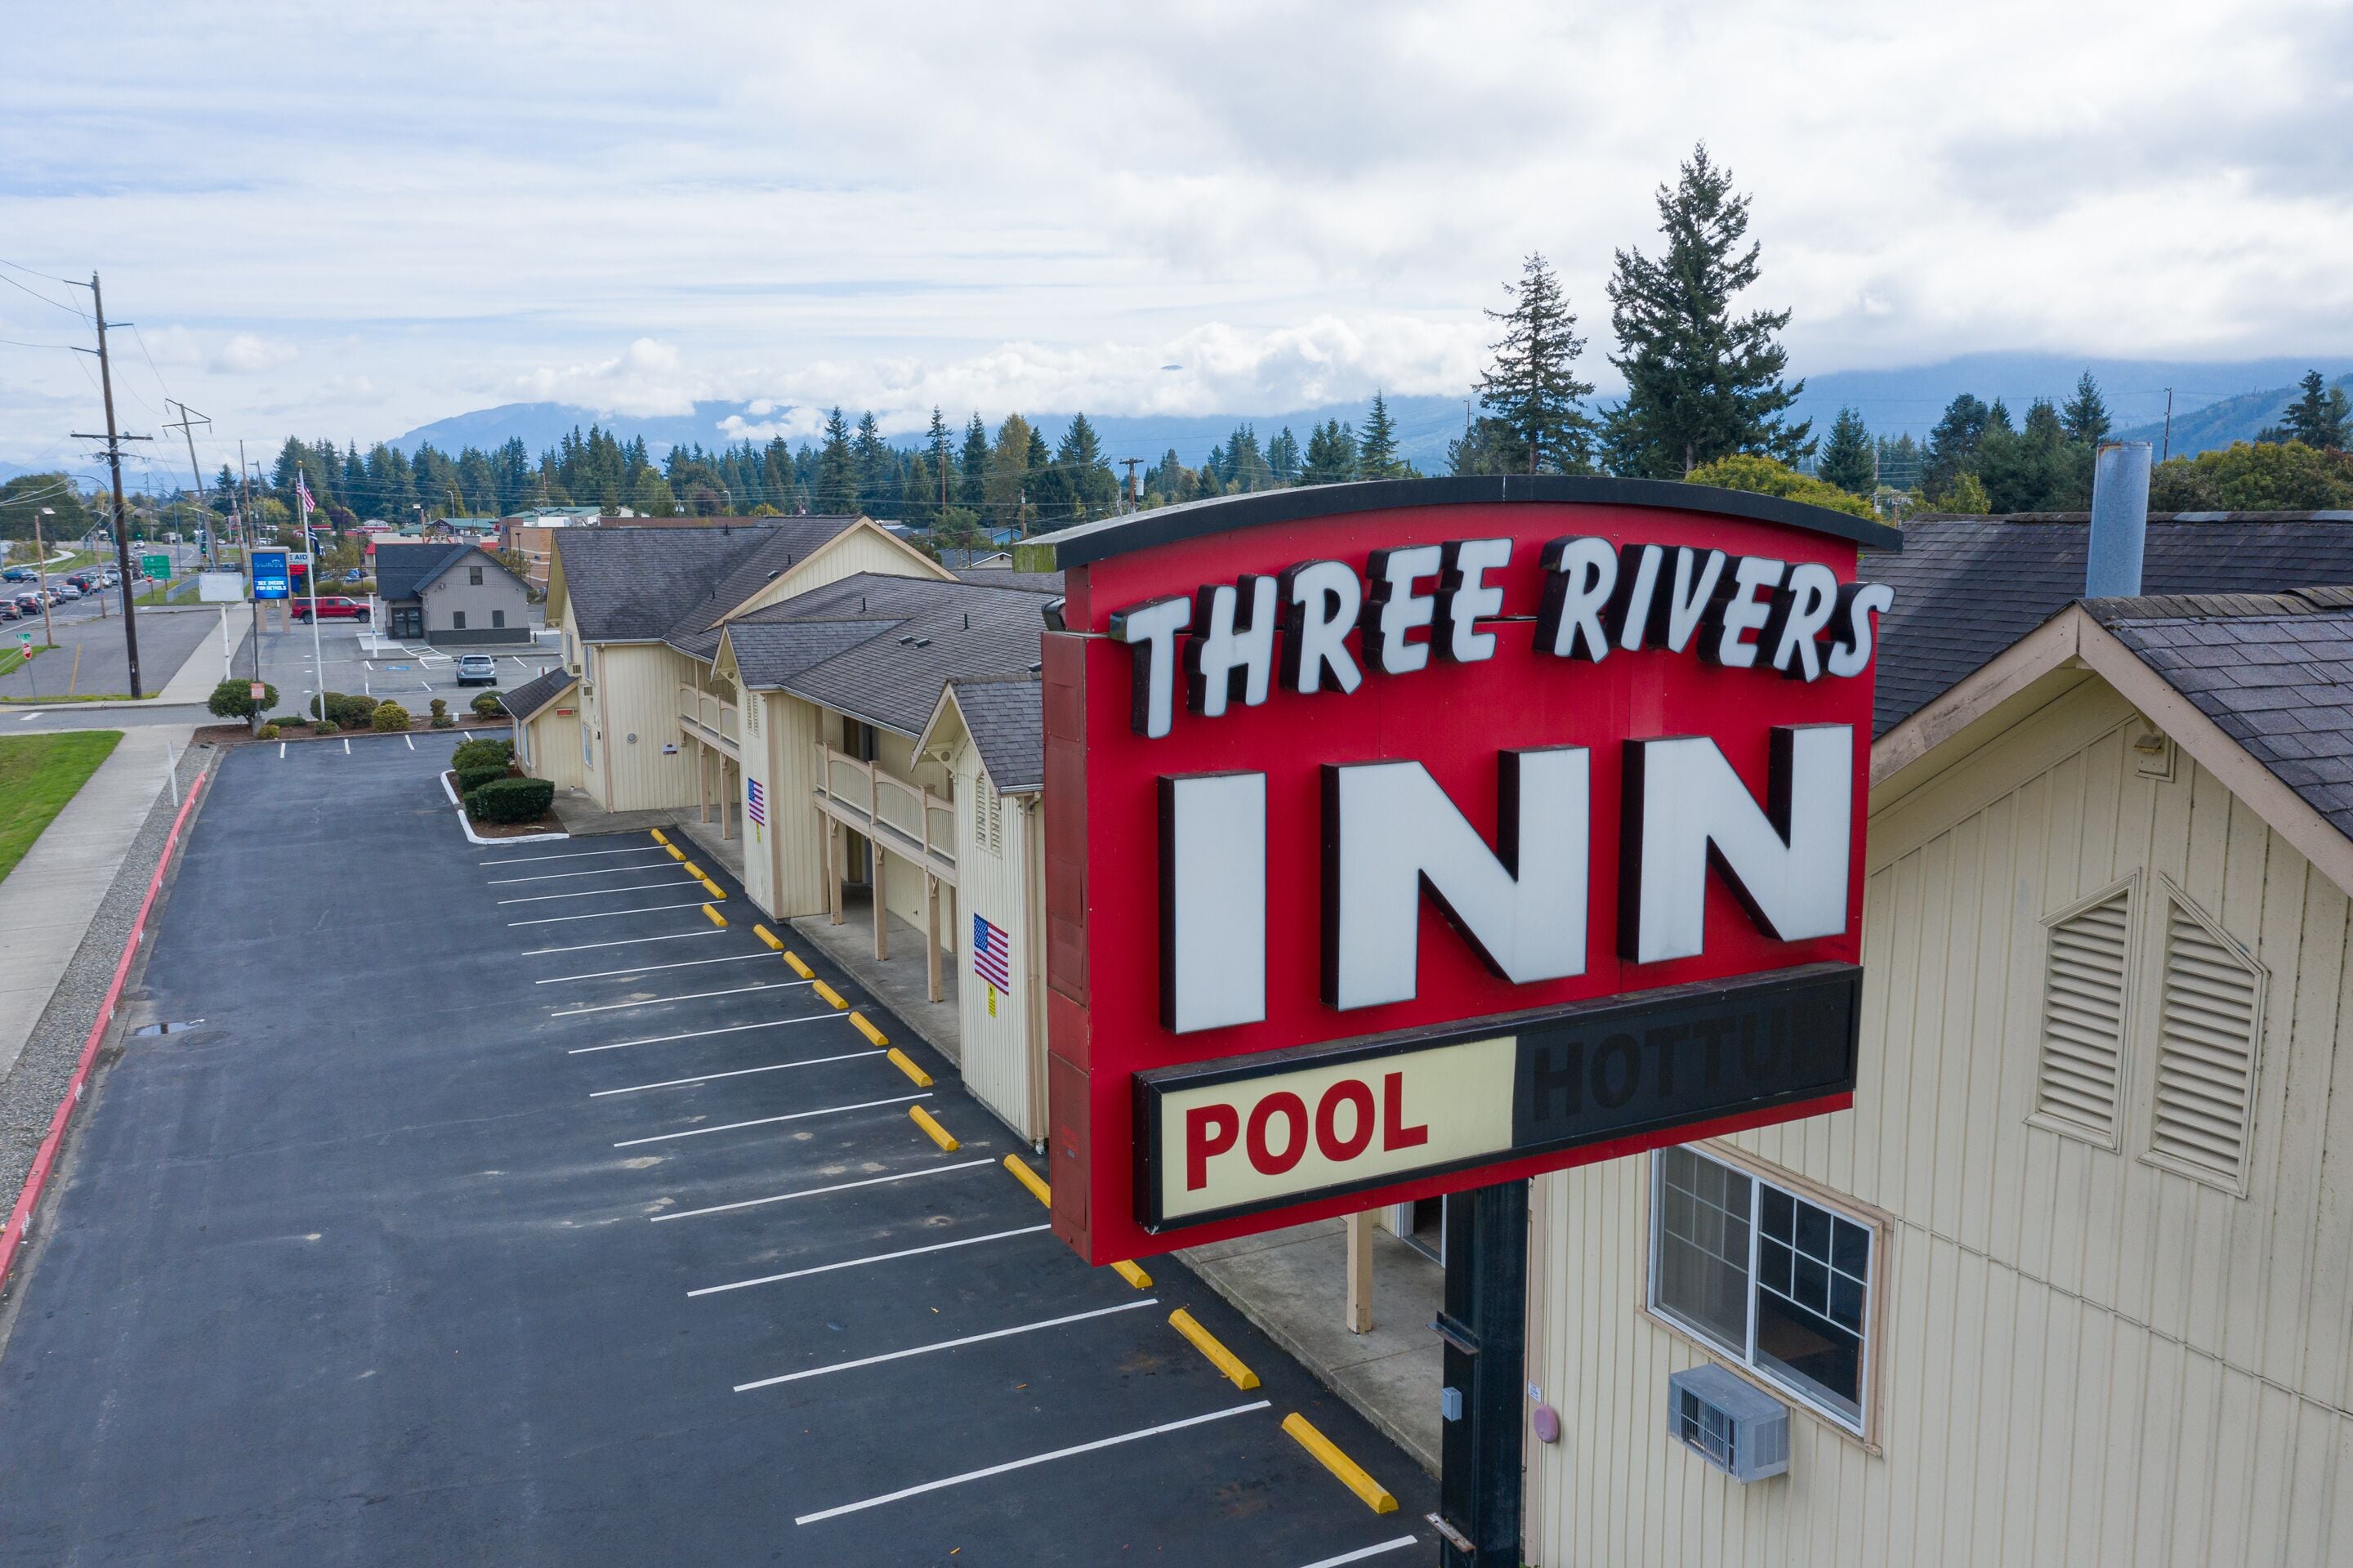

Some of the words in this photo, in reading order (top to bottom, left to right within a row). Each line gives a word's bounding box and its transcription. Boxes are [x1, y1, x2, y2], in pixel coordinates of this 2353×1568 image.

[1116, 538, 1514, 739] THREE
[1544, 534, 1895, 681] RIVERS
[1168, 723, 1854, 1035] INN
[1185, 1071, 1428, 1191] POOL
